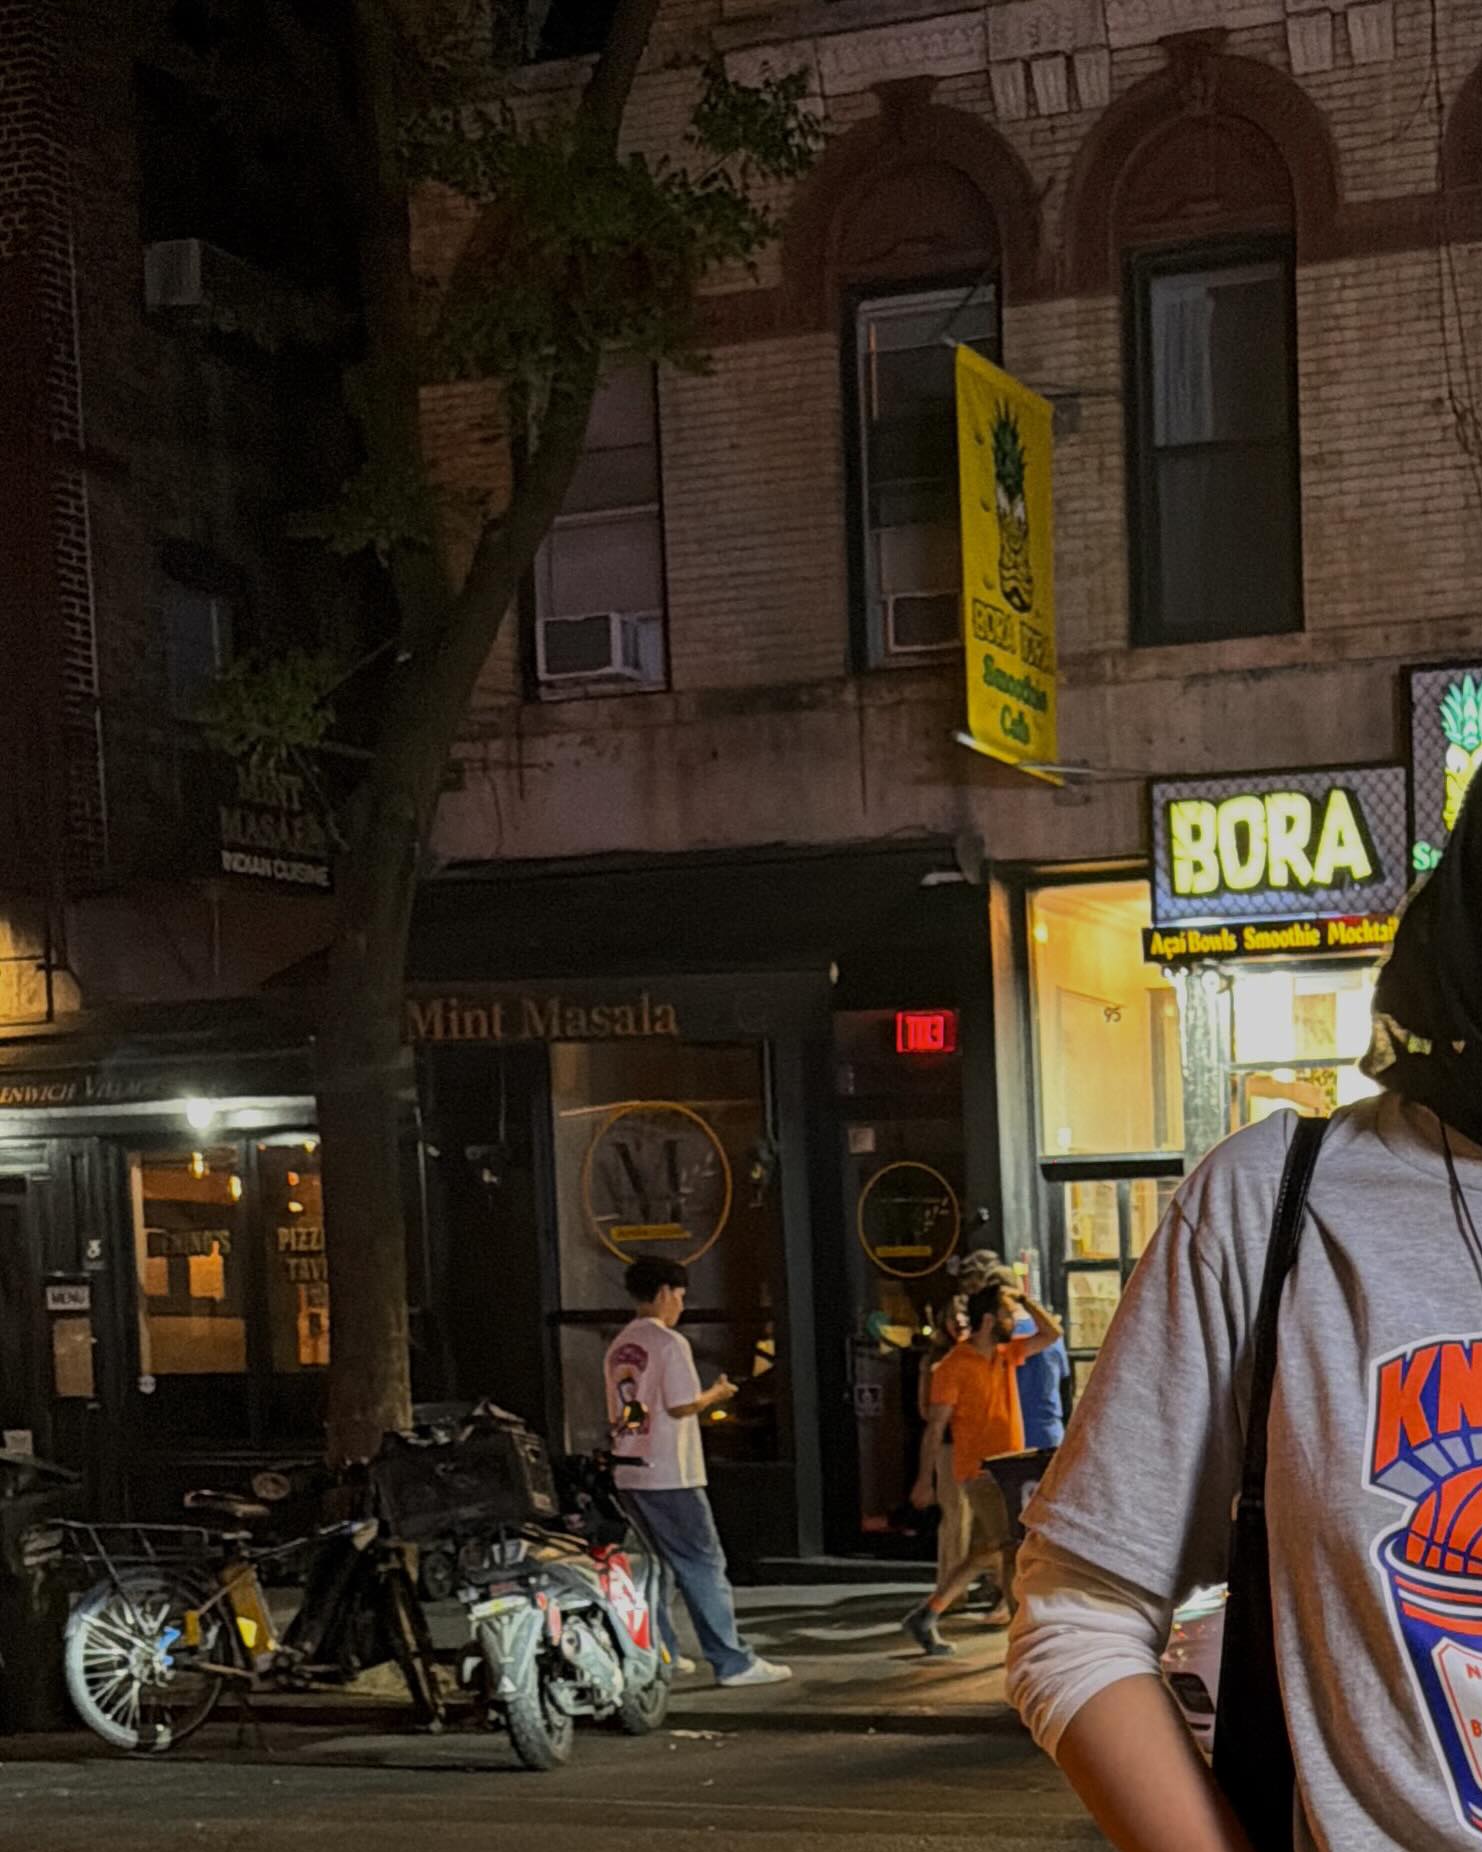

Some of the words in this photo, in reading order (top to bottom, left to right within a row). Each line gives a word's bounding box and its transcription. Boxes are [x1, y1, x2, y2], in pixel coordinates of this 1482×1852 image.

[1169, 789, 1373, 896] BORA
[1187, 926, 1238, 955] Bowls
[1242, 921, 1321, 951] Smoothie
[408, 997, 503, 1041] Mint
[518, 993, 680, 1038] Masala
[1103, 1007, 1122, 1023] 95
